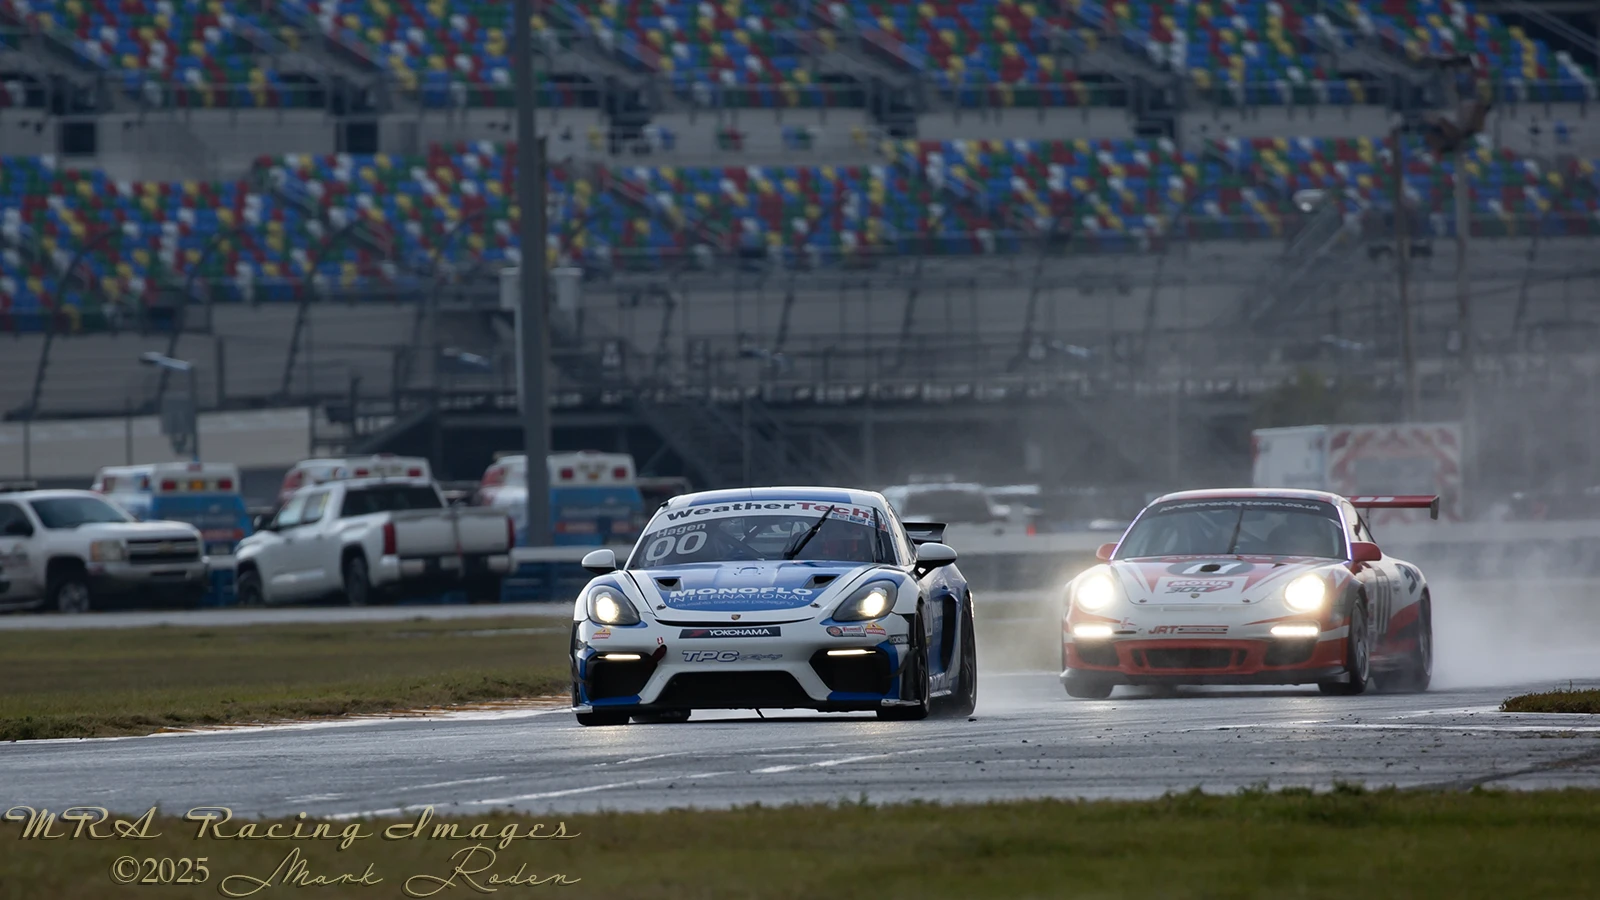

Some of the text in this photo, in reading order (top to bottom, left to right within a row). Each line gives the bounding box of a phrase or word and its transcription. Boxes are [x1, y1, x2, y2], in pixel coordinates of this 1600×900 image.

[667, 501, 870, 521] WeatherTech
[656, 523, 706, 538] Hagen
[646, 531, 708, 562] 00
[1169, 580, 1231, 588] MOTUL
[669, 587, 813, 598] MONOFLO
[668, 593, 809, 604] INTERNATIONAL
[709, 628, 770, 637] YOKOHAMA
[682, 650, 740, 662] TPC
